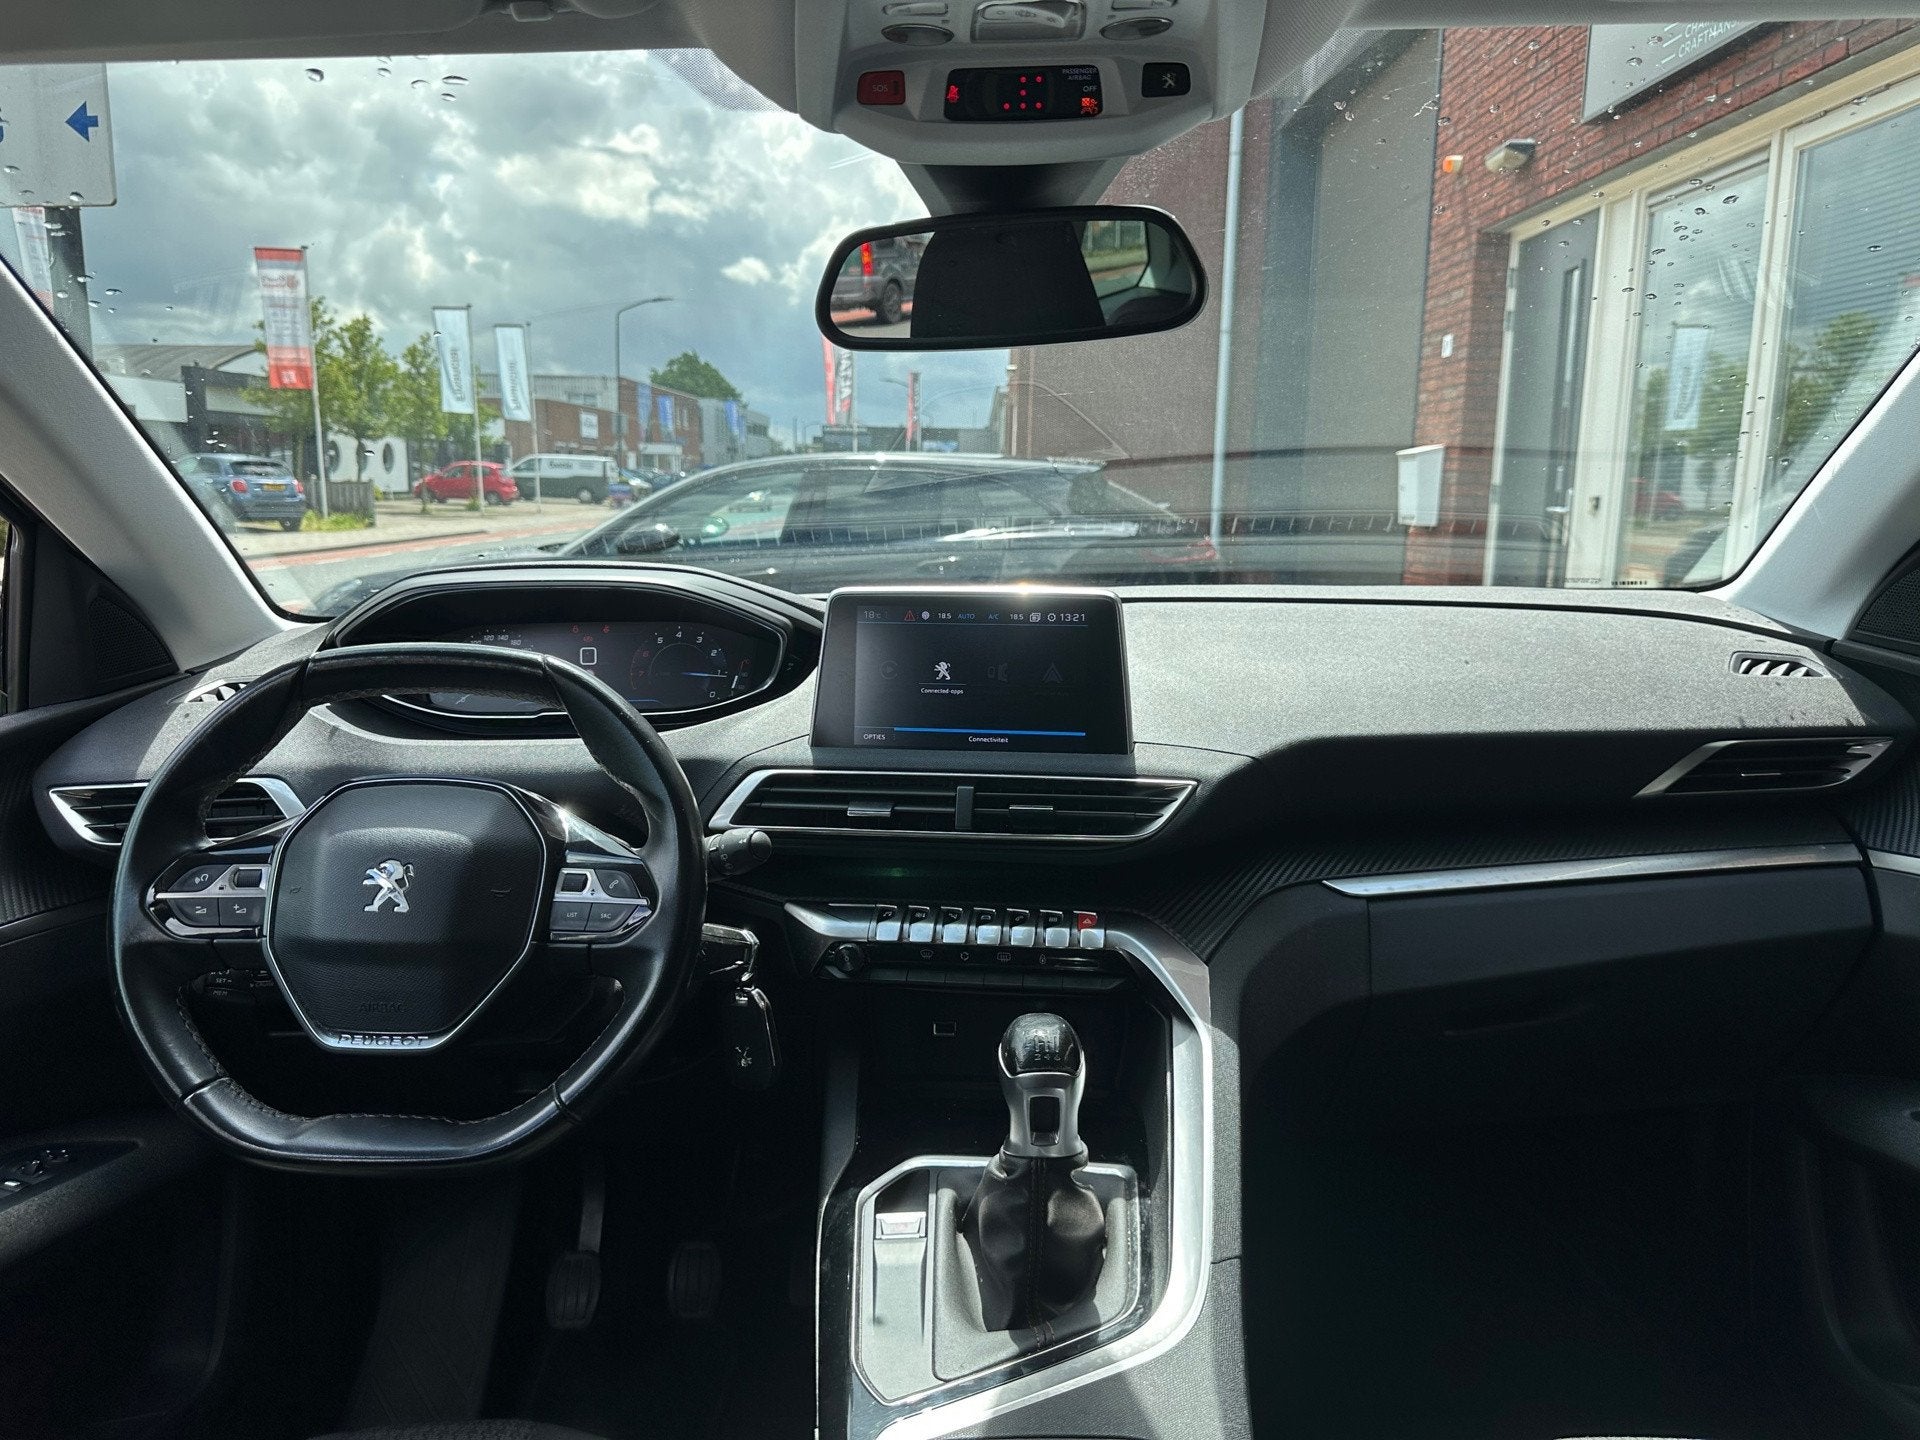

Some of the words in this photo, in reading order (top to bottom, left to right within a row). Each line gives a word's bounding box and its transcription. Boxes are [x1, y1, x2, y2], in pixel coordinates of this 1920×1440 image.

[872, 84, 888, 92] SOS
[657, 636, 664, 645] 5
[696, 636, 703, 644] 3
[710, 649, 718, 657] 2
[968, 735, 1009, 743] Connectiviteit
[338, 1033, 429, 1047] PEUGEOT
